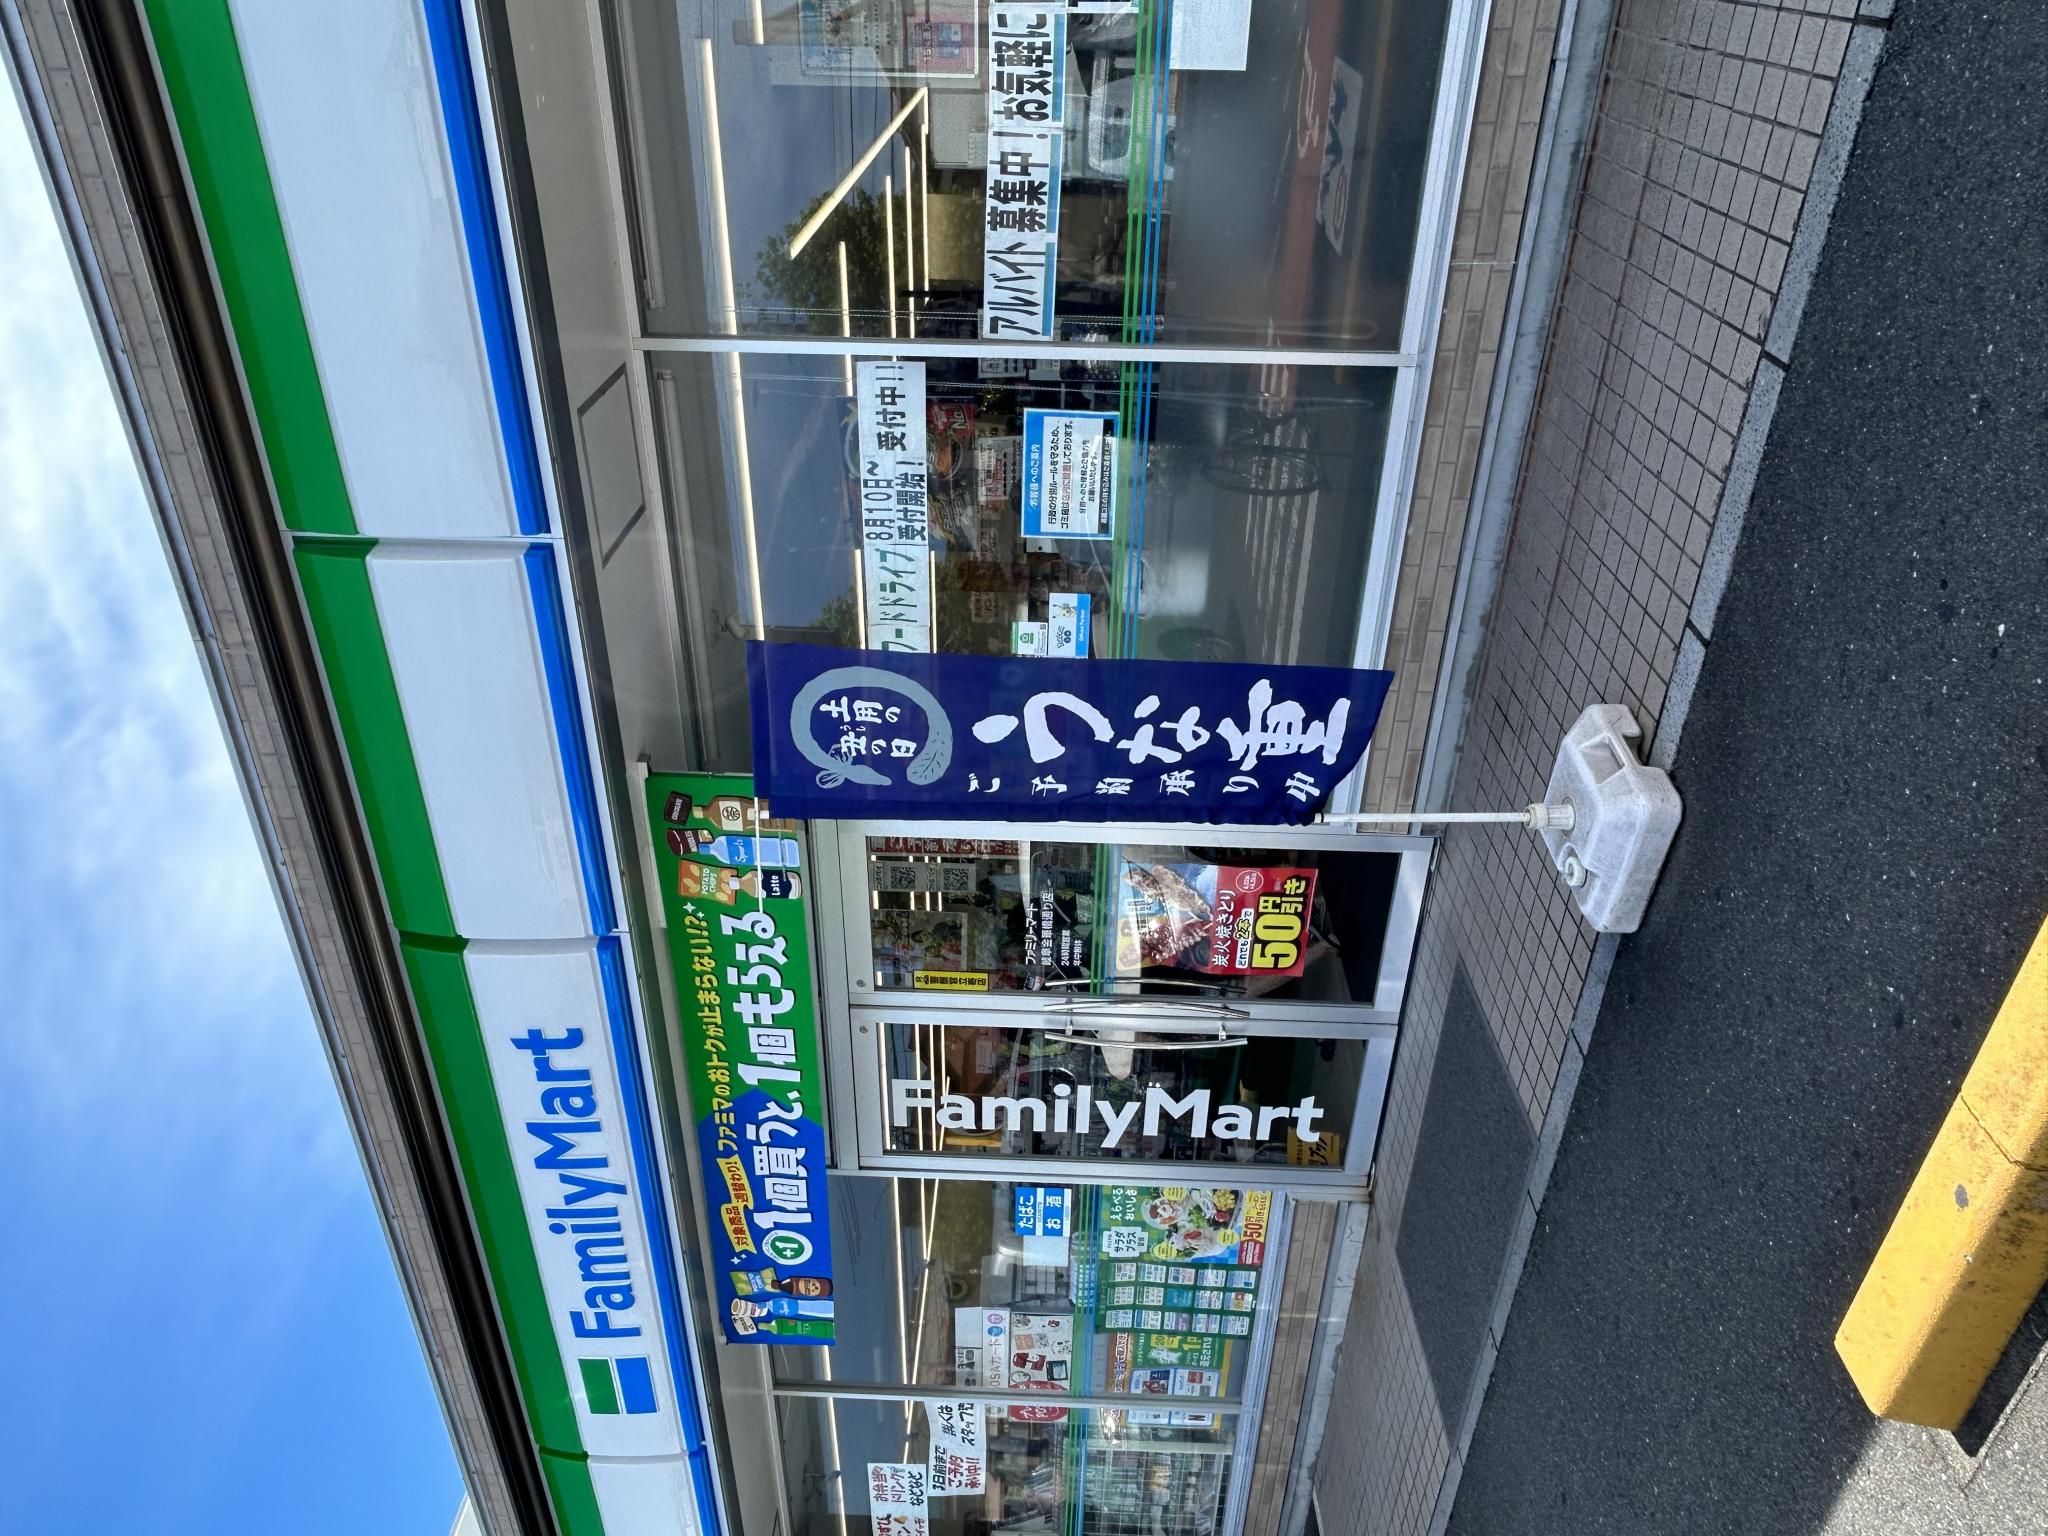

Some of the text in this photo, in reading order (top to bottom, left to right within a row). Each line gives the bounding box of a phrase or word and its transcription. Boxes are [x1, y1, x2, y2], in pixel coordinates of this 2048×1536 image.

[990, 13, 1054, 122] お気軽に
[985, 241, 1046, 336] アルバイト
[1030, 444, 1040, 507] お客様へのご案内
[874, 548, 918, 652] フードドライブ
[820, 696, 901, 724] 土用の
[971, 679, 1351, 772] うな重
[839, 724, 866, 732] うし
[840, 731, 917, 758] 丑の日
[967, 769, 1321, 802] ご予約承り中
[702, 868, 710, 895] POTATO
[709, 872, 718, 893] CHIPS
[770, 875, 781, 896] Latte
[1025, 902, 1039, 965] ファミリーマート
[1041, 891, 1054, 966] 岐阜金華橋通り店
[1213, 890, 1235, 967] 炭火焼きとり
[1061, 929, 1071, 966] 24時間営業
[1073, 939, 1083, 966] 年中無休
[684, 915, 738, 1151] ファミマのおトクが止まらない!?
[892, 1079, 1324, 1148] FamilyMart
[510, 1028, 641, 1338] FamilyMart
[1017, 1195, 1034, 1228] たばこ
[1110, 1188, 1124, 1221] えらべる
[1124, 1188, 1138, 1221] おいしさ
[724, 1206, 749, 1246] 対象商品
[1114, 1231, 1125, 1253] サラダ
[1125, 1232, 1136, 1252] プラス
[932, 1445, 946, 1491] 3日前まで
[948, 1455, 964, 1488] ご予約
[908, 1471, 924, 1506] などなど
